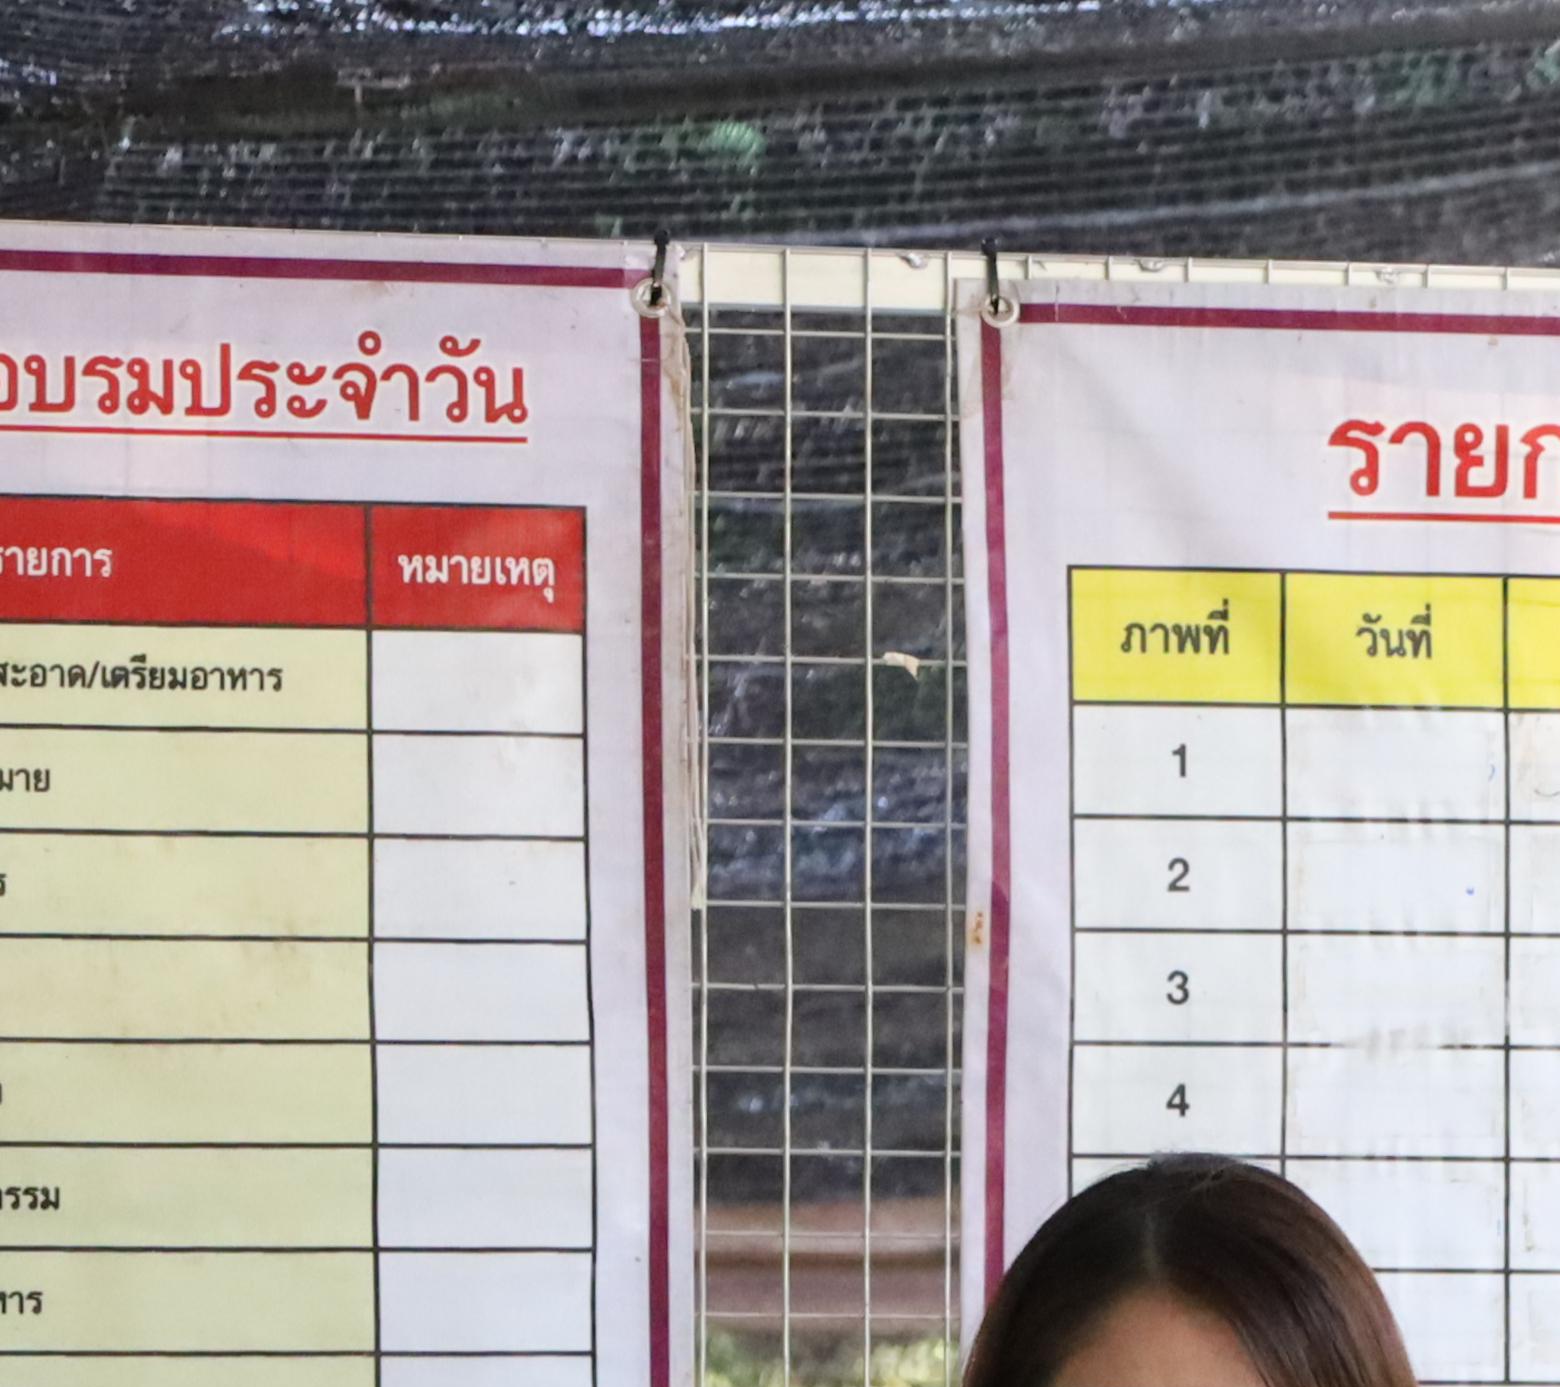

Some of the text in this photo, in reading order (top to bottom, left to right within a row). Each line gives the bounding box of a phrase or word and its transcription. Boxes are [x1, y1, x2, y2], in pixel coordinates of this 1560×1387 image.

[0, 546, 113, 578] ายการ
[398, 553, 556, 604] หมายเหตุ
[1120, 598, 1231, 656] ภาพที่
[1355, 603, 1434, 660] วันที่
[1171, 744, 1188, 779] 1
[1168, 858, 1191, 894] 2
[1167, 970, 1191, 1006] 3
[1166, 1084, 1191, 1119] 4
[0, 1186, 61, 1212] รรม
